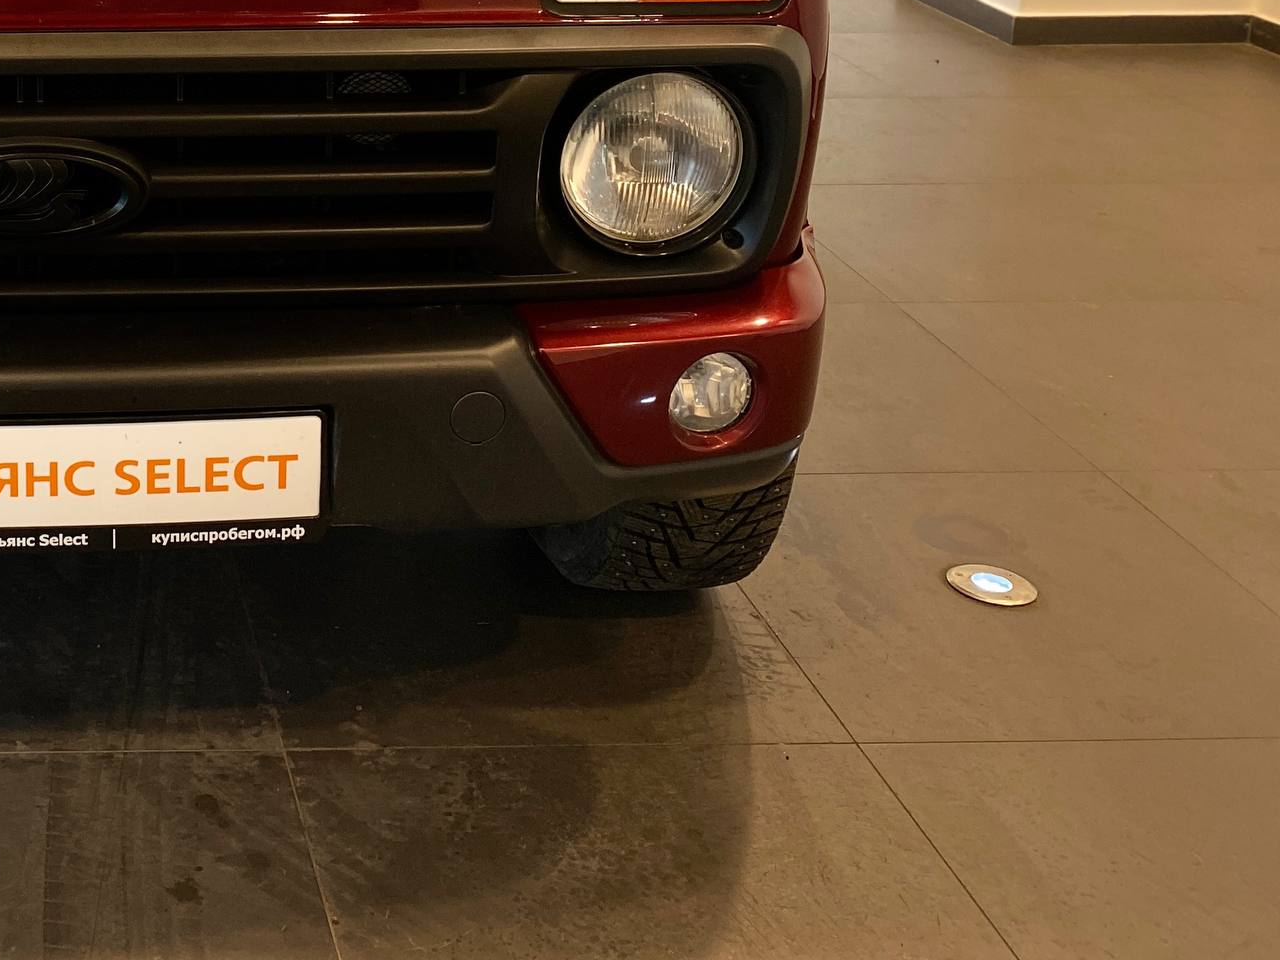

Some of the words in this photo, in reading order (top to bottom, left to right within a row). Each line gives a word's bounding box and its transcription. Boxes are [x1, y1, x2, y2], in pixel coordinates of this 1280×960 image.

[115, 454, 300, 496] SELECT
[39, 533, 89, 547] Select
[151, 524, 306, 545] куписпробегом.рф
